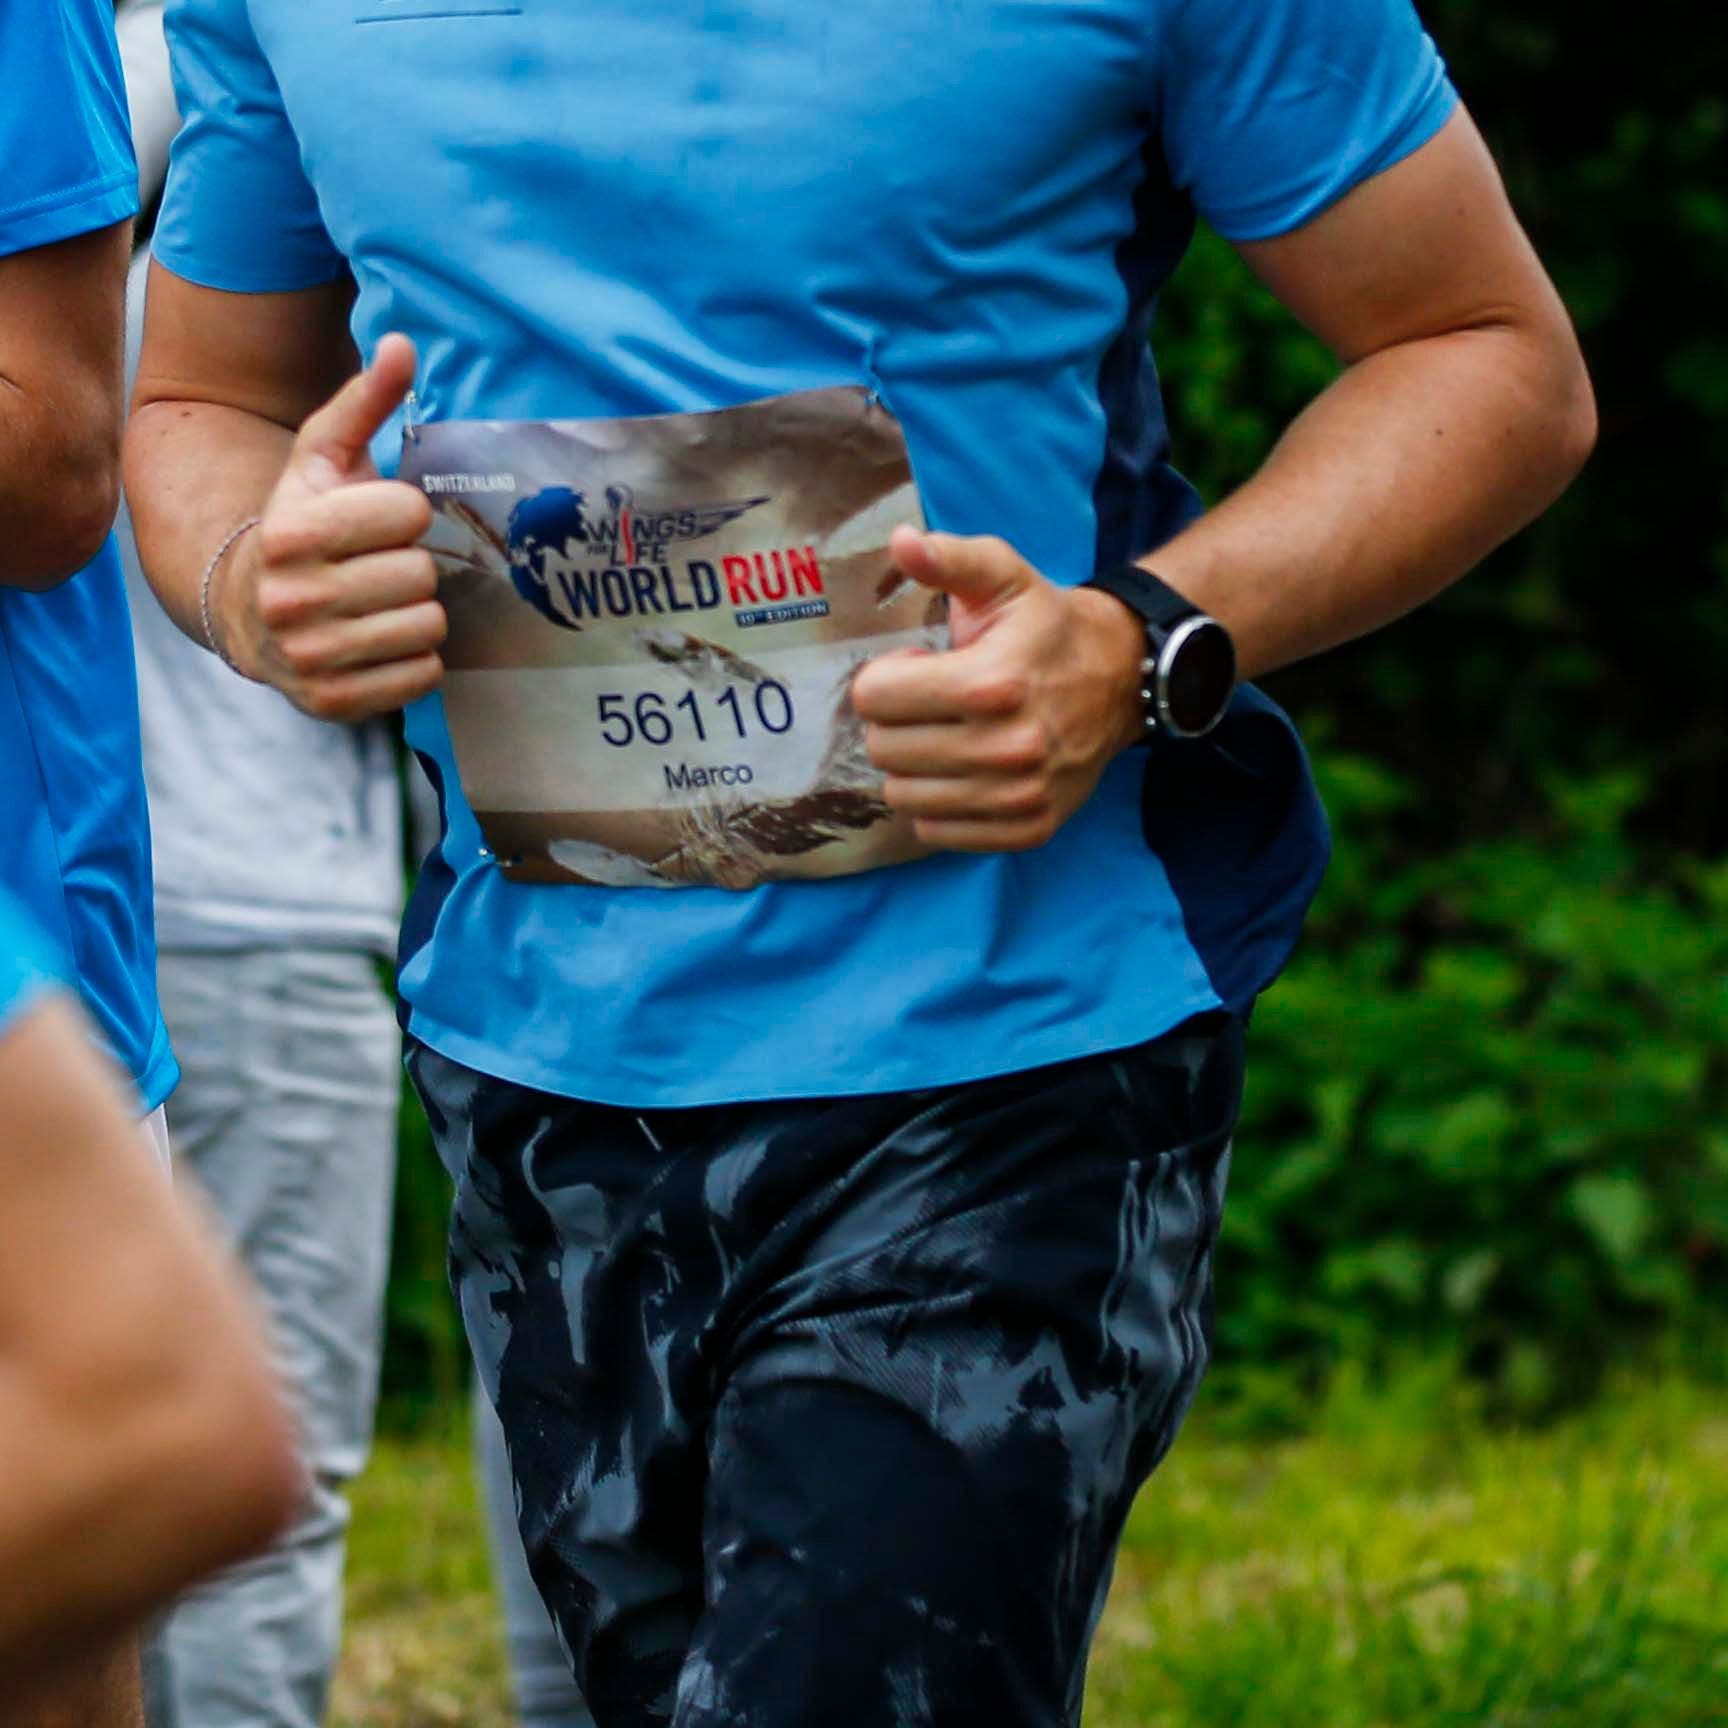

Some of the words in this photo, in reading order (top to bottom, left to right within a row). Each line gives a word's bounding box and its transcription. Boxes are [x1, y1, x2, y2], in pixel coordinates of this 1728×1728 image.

[586, 509, 698, 542] WINGS
[609, 539, 668, 567] LIFE
[560, 559, 722, 619] WORLD
[721, 545, 825, 606] RUN
[596, 678, 795, 747] 56110
[663, 760, 754, 791] Marco
